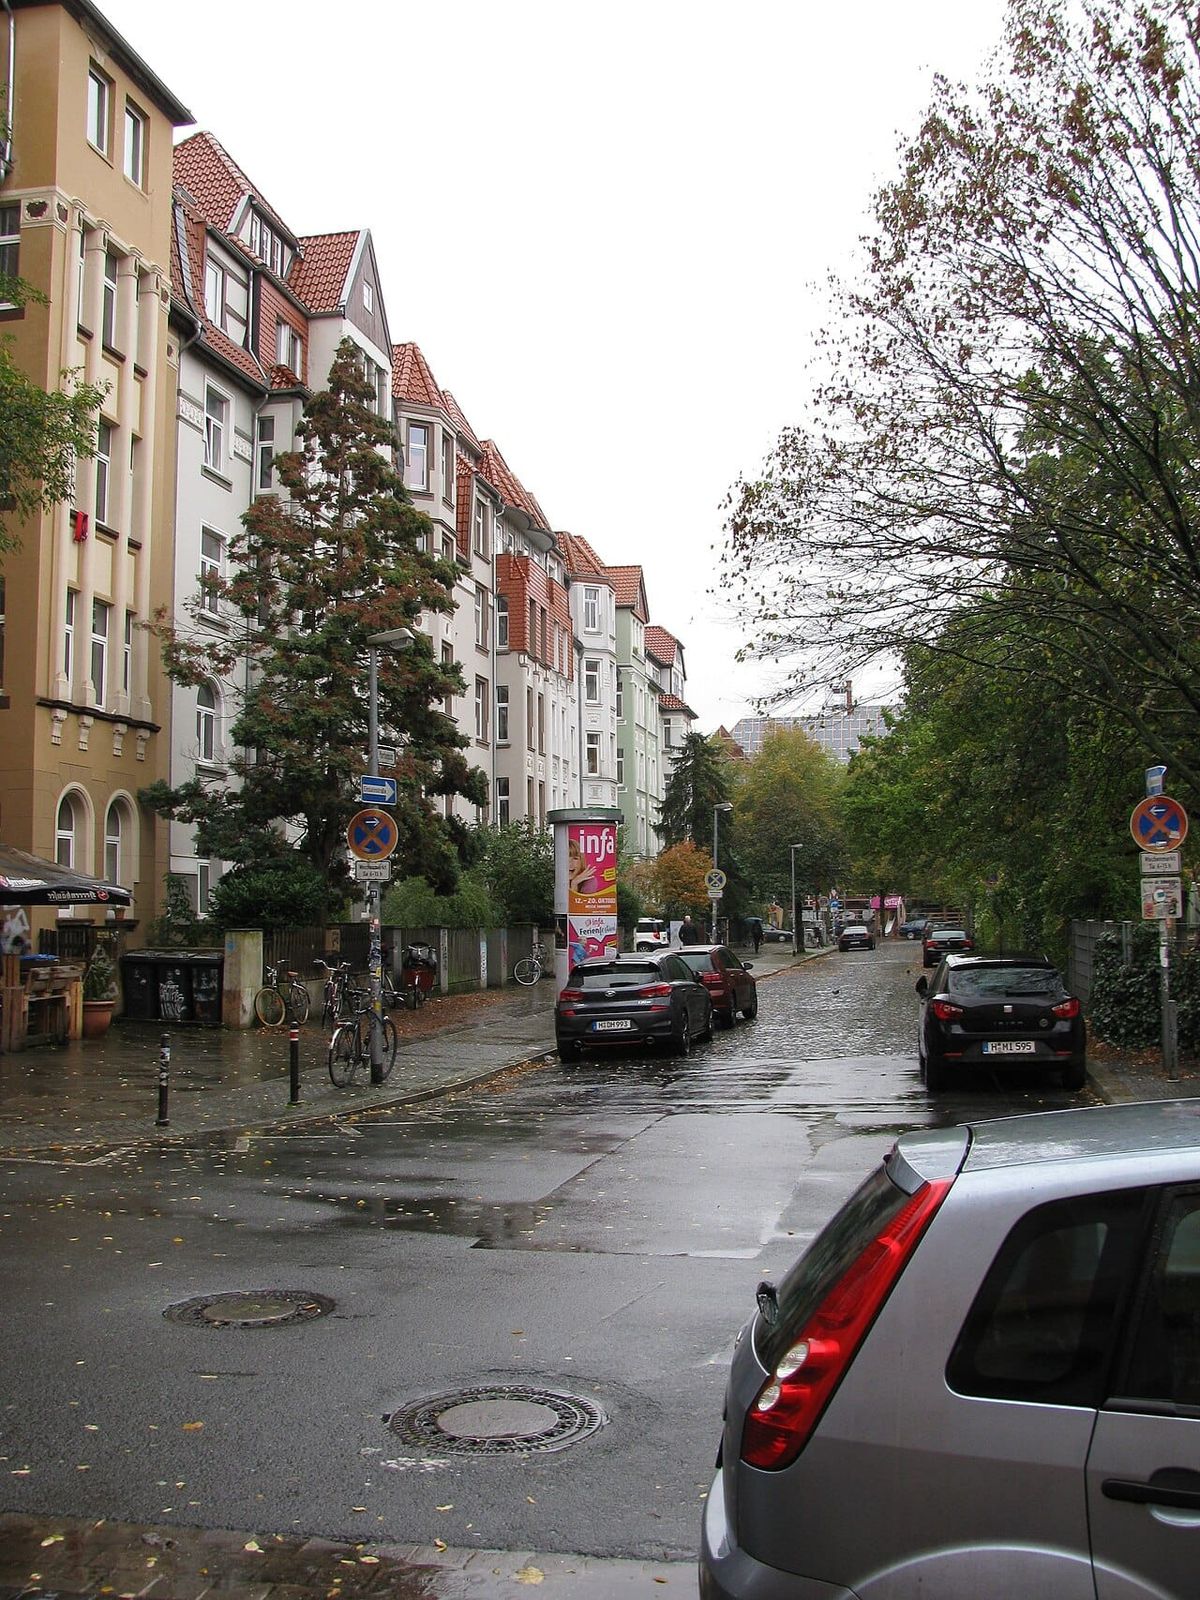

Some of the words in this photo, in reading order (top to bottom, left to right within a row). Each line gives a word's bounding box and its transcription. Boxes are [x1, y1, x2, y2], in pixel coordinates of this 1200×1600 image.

[579, 828, 615, 862] infa
[616, 1020, 629, 1028] 993
[991, 1043, 997, 1051] H
[1002, 1043, 1013, 1051] MI
[1015, 1042, 1032, 1051] 595
